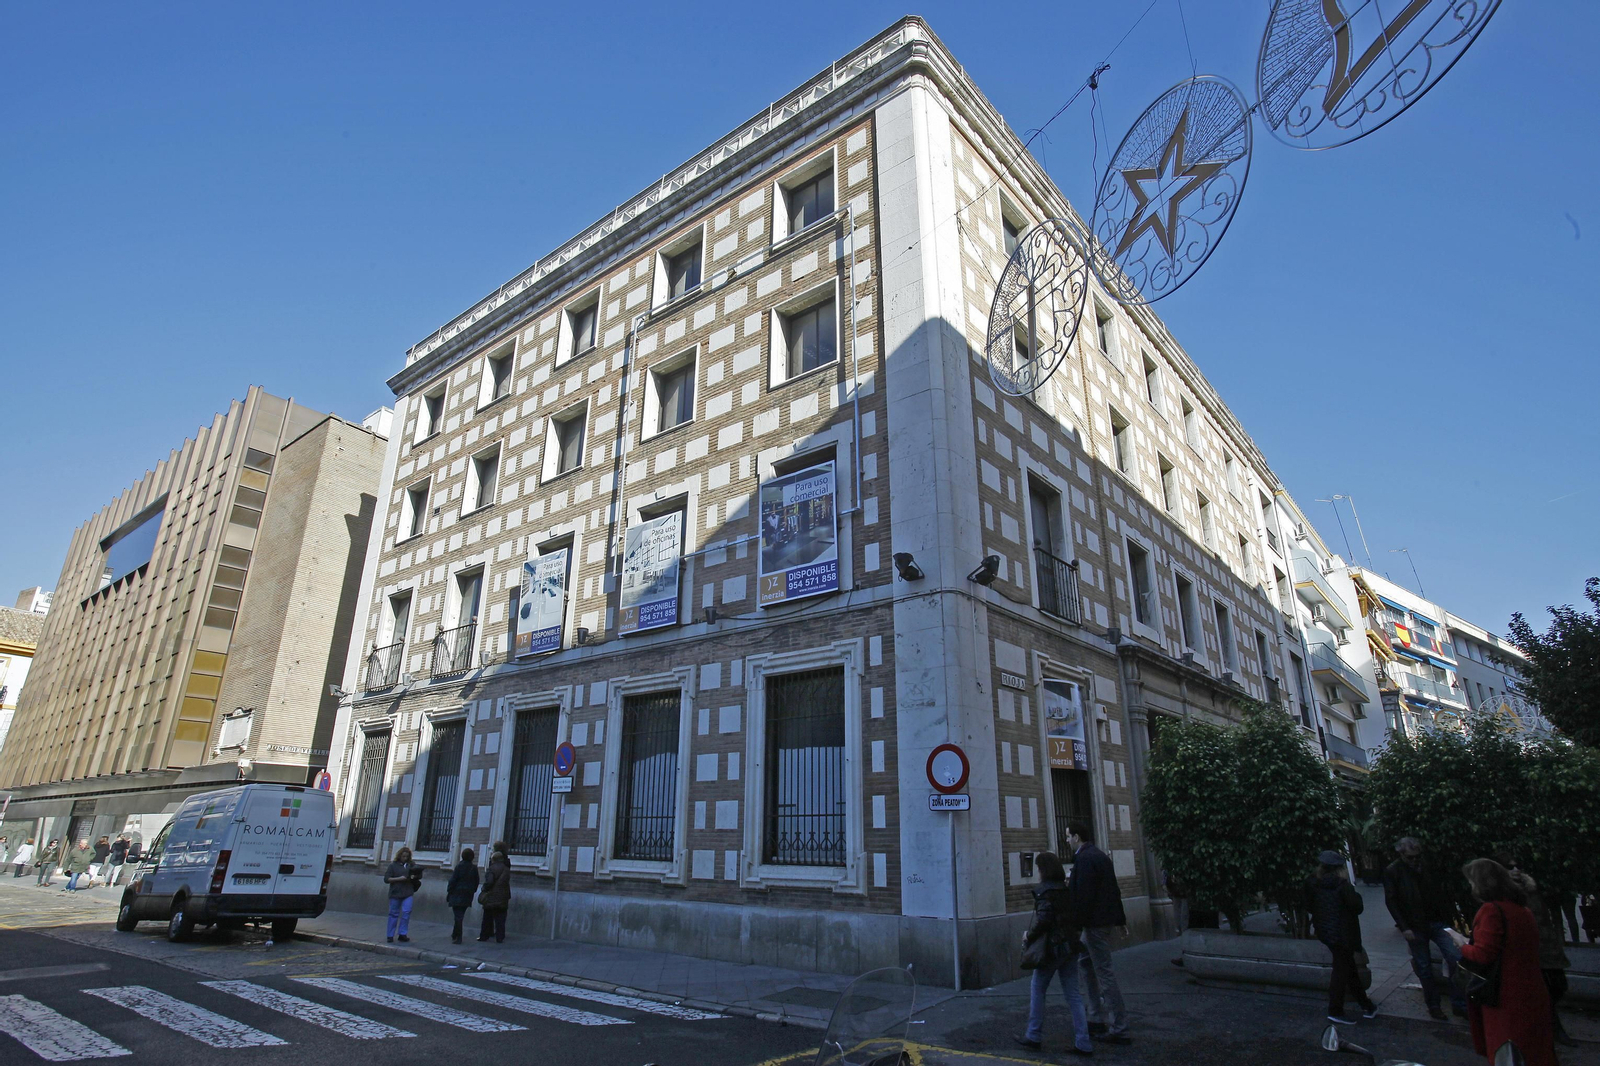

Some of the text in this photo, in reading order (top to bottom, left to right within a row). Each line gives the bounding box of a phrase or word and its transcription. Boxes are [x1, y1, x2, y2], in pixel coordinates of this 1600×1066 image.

[796, 477, 828, 492] Para uso
[790, 484, 828, 503] comercial
[652, 525, 676, 536] Para uso
[653, 533, 676, 544] oficinas
[554, 560, 562, 568] uso
[788, 563, 836, 581] DISPONIBLE
[788, 573, 836, 590] 954 571 858
[762, 590, 784, 601] inerzia
[641, 600, 676, 614] DISPONIBLE
[640, 614, 651, 622] 954
[652, 612, 663, 620] 571
[620, 622, 637, 630] inerzia
[533, 628, 560, 640] DISPONIBLE
[532, 638, 541, 647] 954
[1002, 675, 1025, 689] RIOJA
[1050, 757, 1072, 766] inerzia
[1074, 753, 1083, 761] 954
[244, 825, 325, 838] ROMALCAM
